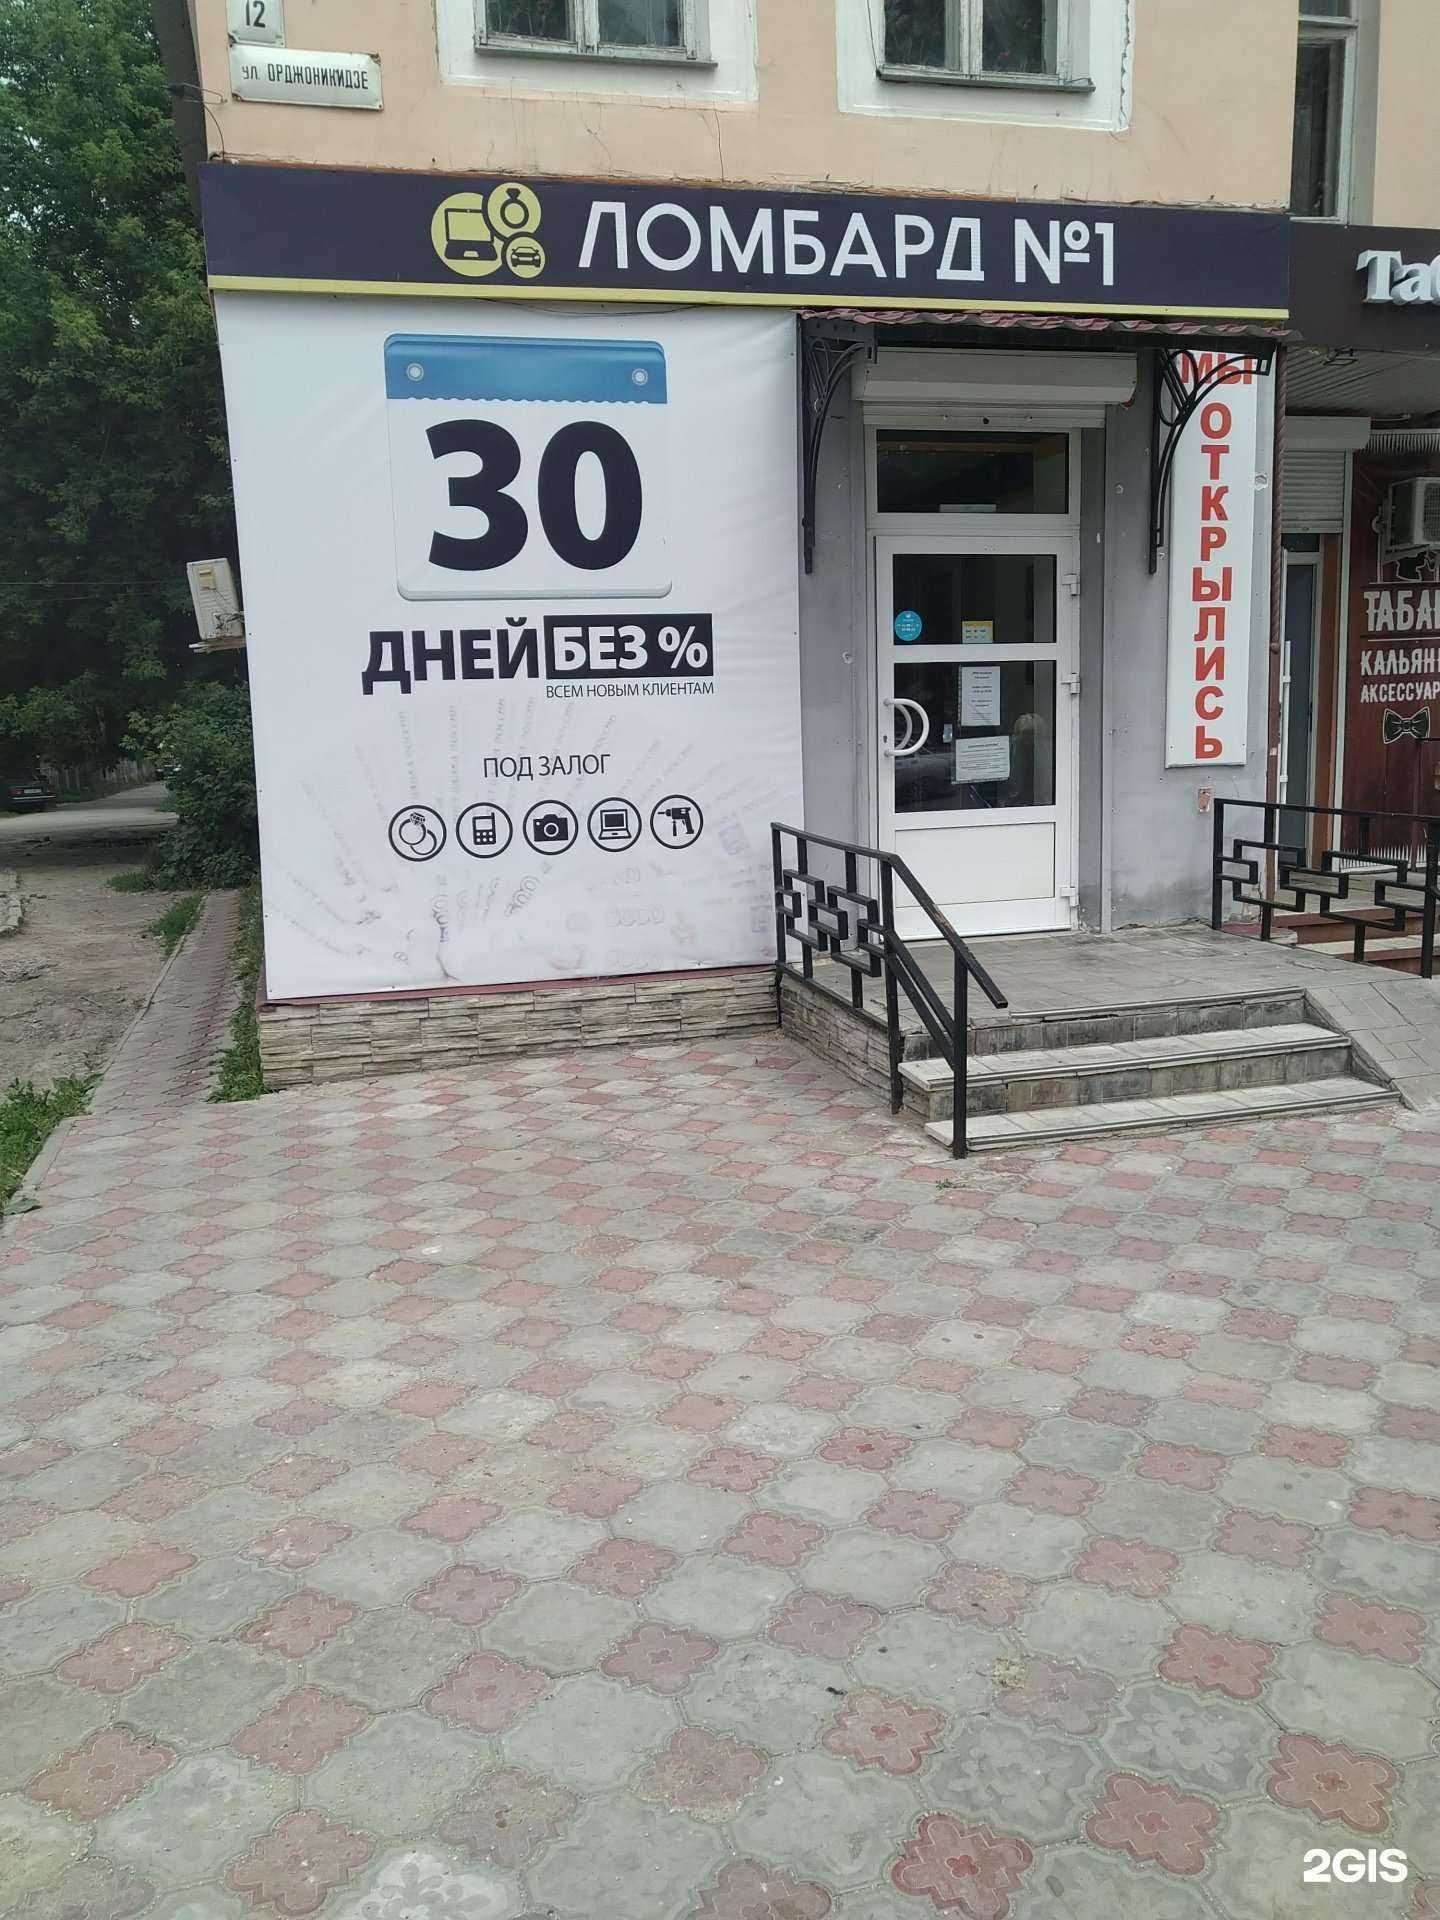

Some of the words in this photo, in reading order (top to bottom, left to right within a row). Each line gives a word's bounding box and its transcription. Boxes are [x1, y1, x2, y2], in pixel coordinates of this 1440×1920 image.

[245, 0, 266, 28] 12
[267, 63, 369, 90] ОРДЖОНИКИДЗЕ
[578, 200, 985, 282] ЛОМБАРД
[425, 418, 643, 572] 30
[1191, 401, 1233, 760] ОТКРЫЛИСЬ
[361, 616, 540, 696] ДНЕЙ
[552, 625, 648, 671] БЕЗ
[658, 625, 708, 670] %
[1361, 647, 1440, 676] КАЛЬЯН
[545, 684, 584, 699] ВСЕМ
[586, 683, 640, 698] НОВЫМ
[642, 681, 715, 697] КЛИЕНТАМ
[483, 756, 534, 781] ПОД
[538, 752, 612, 778] ЗАЛОГ
